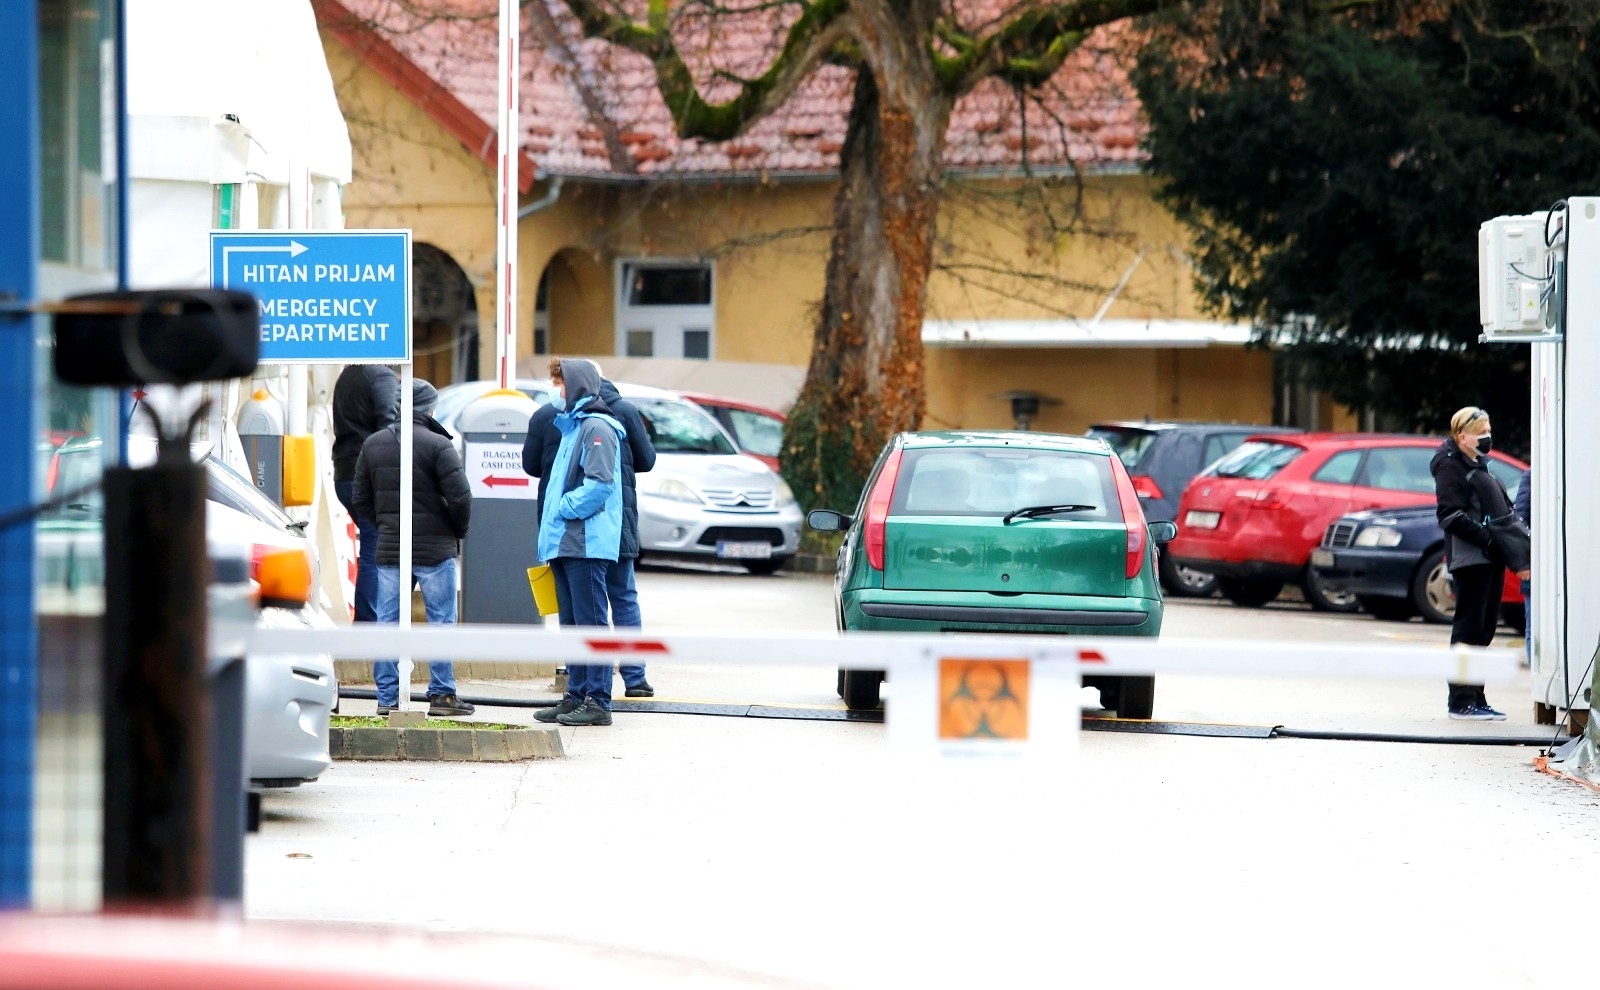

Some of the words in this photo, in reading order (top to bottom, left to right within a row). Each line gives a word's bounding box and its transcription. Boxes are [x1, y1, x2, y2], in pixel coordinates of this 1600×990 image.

[243, 264, 308, 283] HITAN
[315, 264, 395, 282] PRIJAM
[259, 299, 378, 317] MERGENCY
[259, 323, 390, 342] EPARTMENT
[483, 451, 522, 460] BLAGAJN
[257, 461, 265, 488] CAME
[481, 461, 503, 469] CASH
[505, 462, 521, 470] DES
